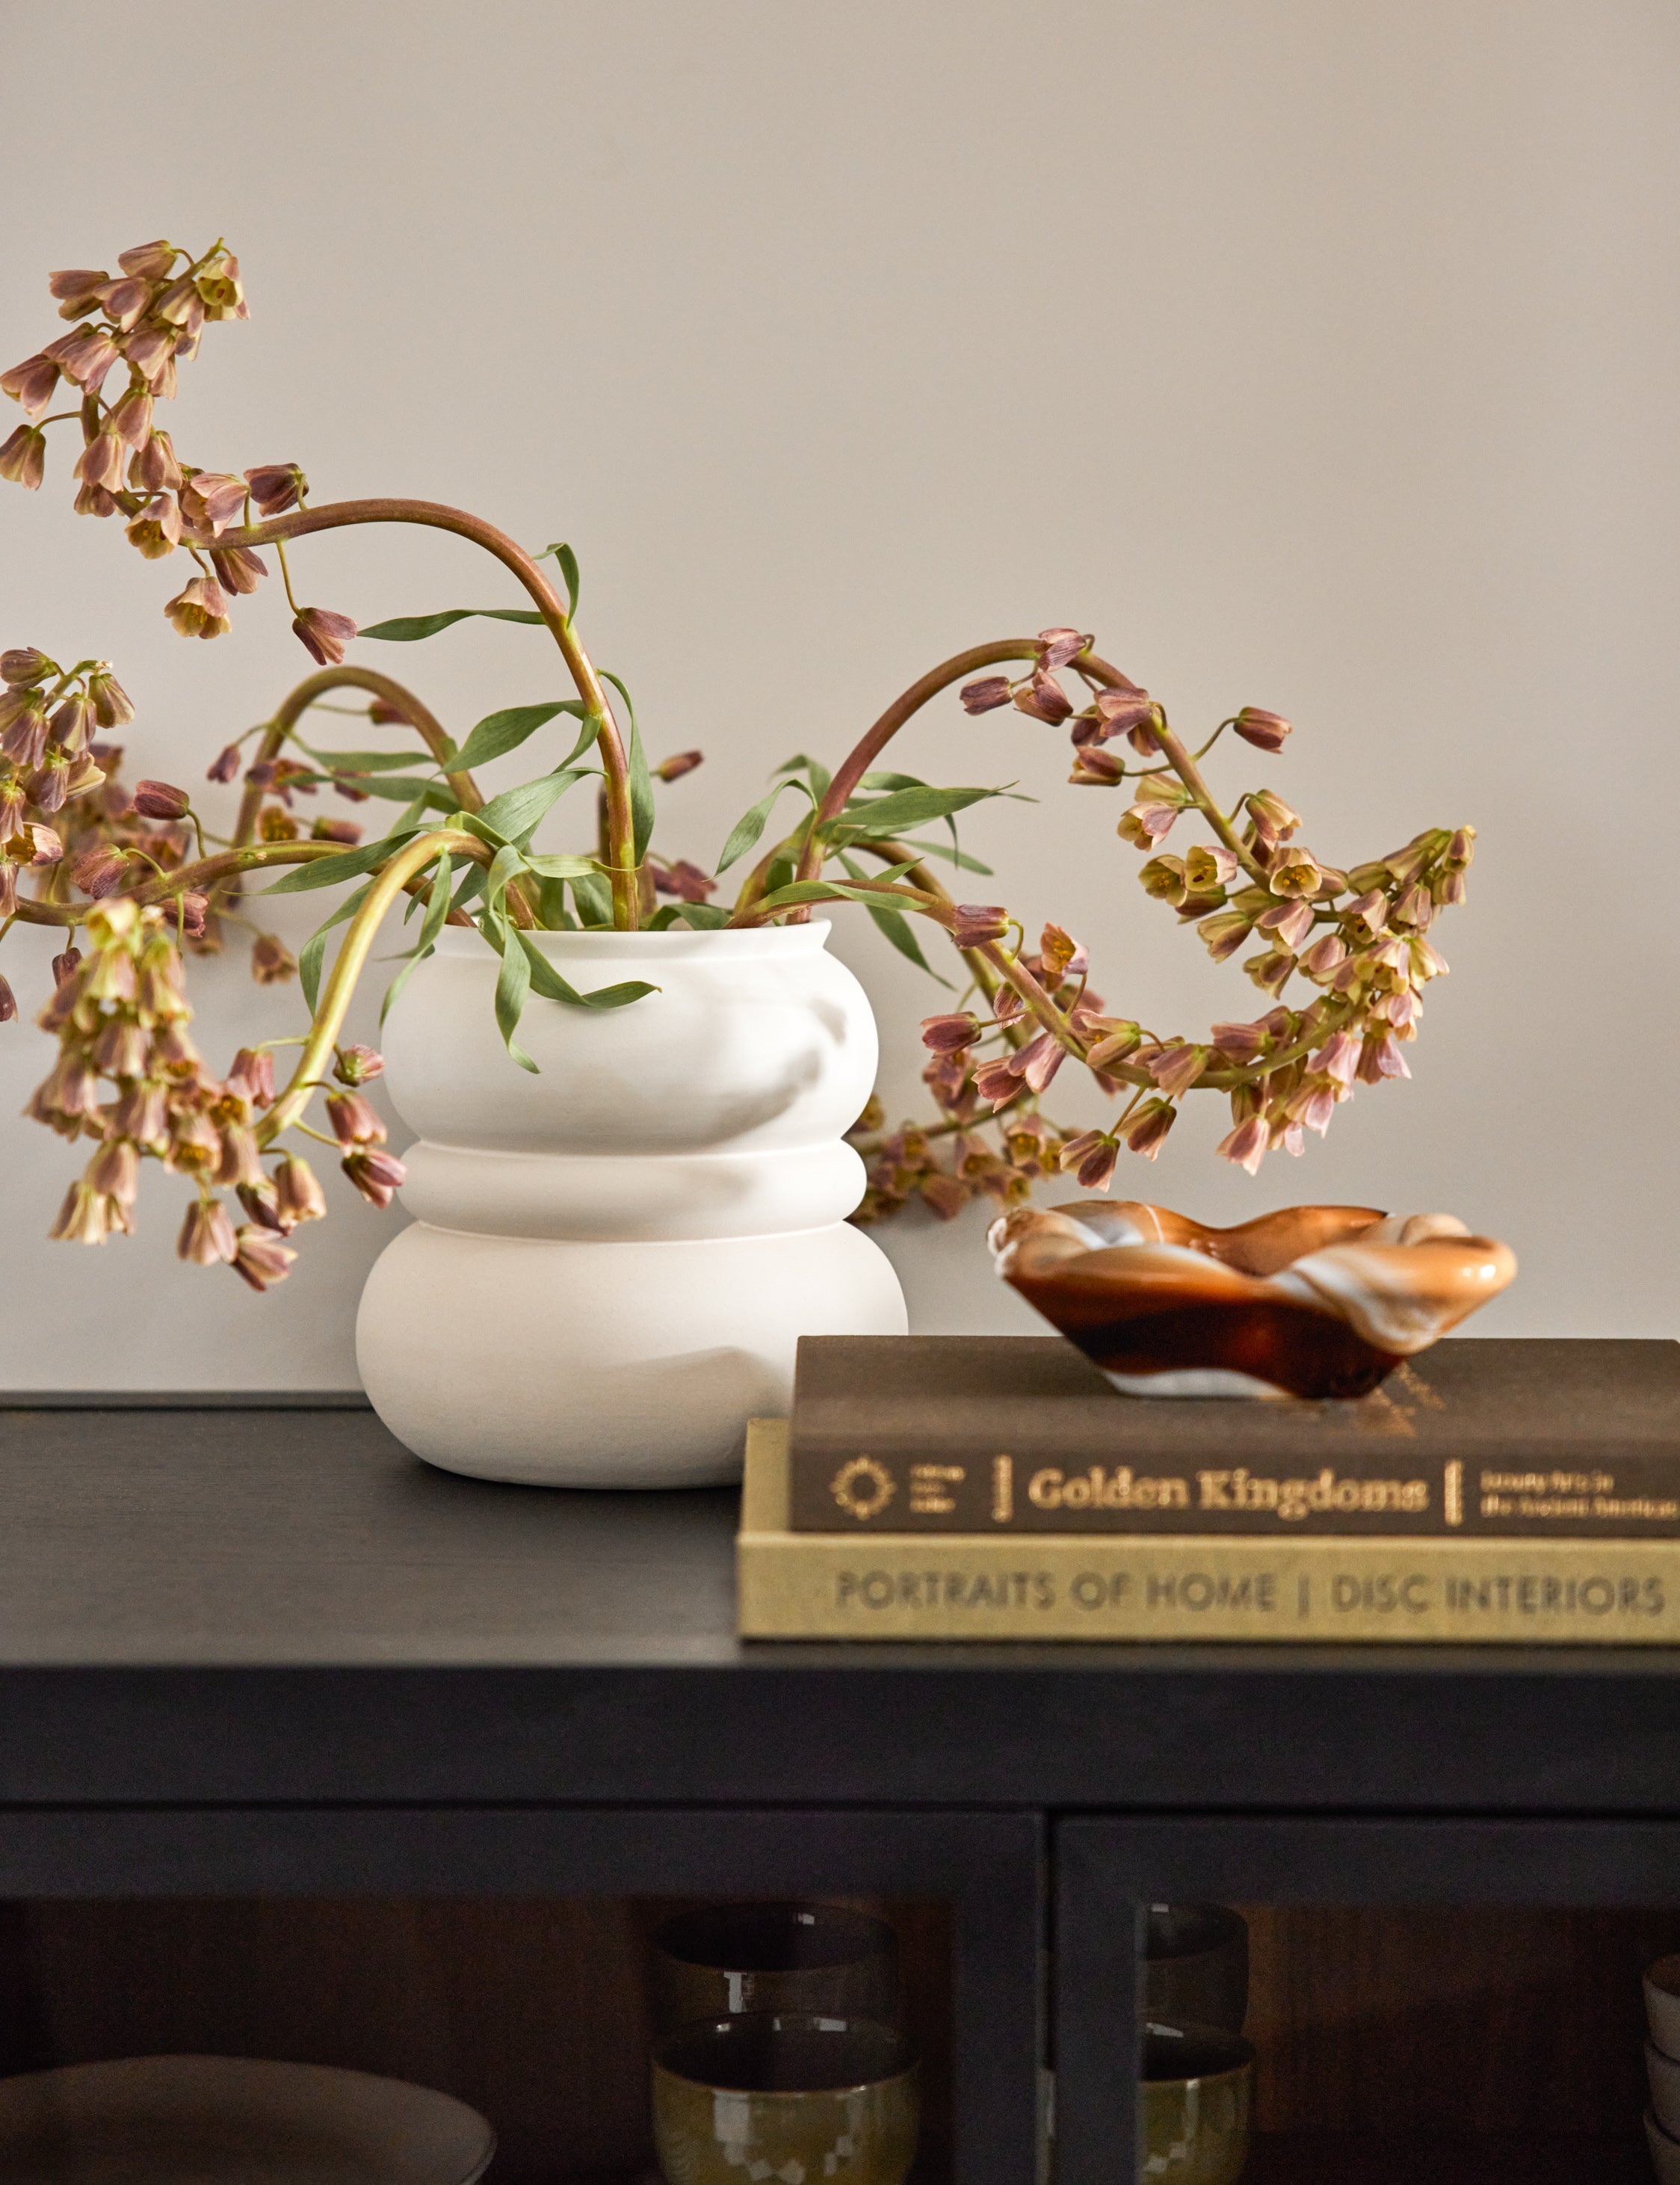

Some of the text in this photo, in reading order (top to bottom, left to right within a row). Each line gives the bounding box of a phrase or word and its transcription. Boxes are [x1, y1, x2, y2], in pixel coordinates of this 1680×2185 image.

[1028, 1467, 1190, 1509] Golden
[1196, 1468, 1429, 1521] Kingdoms
[835, 1571, 1056, 1610] PORTRAITS
[1071, 1572, 1131, 1612] OF
[1146, 1573, 1276, 1613] HOME
[1332, 1575, 1427, 1615] DISC
[1445, 1577, 1666, 1617] INTERIORS
